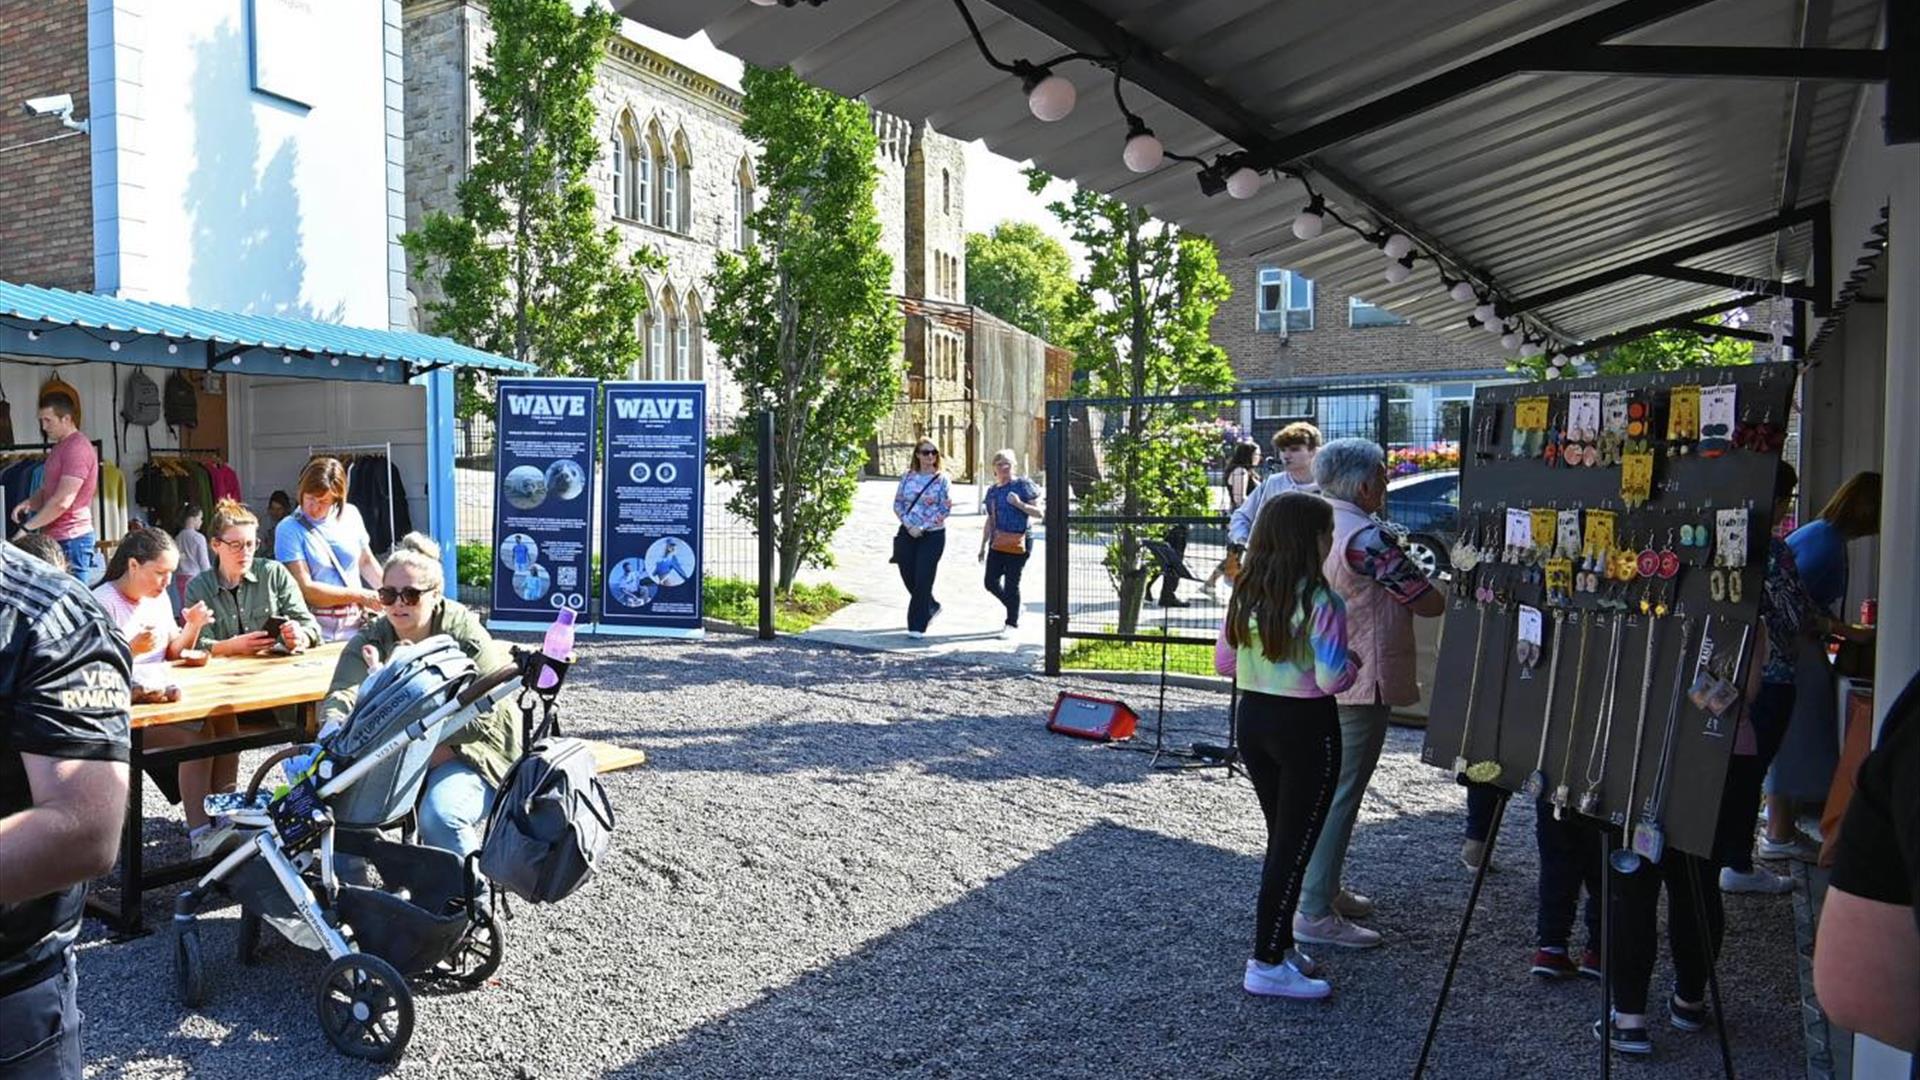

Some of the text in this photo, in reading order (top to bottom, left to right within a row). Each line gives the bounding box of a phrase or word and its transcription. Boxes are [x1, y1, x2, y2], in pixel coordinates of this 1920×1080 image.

[508, 395, 585, 416] WAVE
[614, 398, 694, 419] WAVE
[82, 670, 122, 690] VISIT
[375, 741, 400, 758] VISTA
